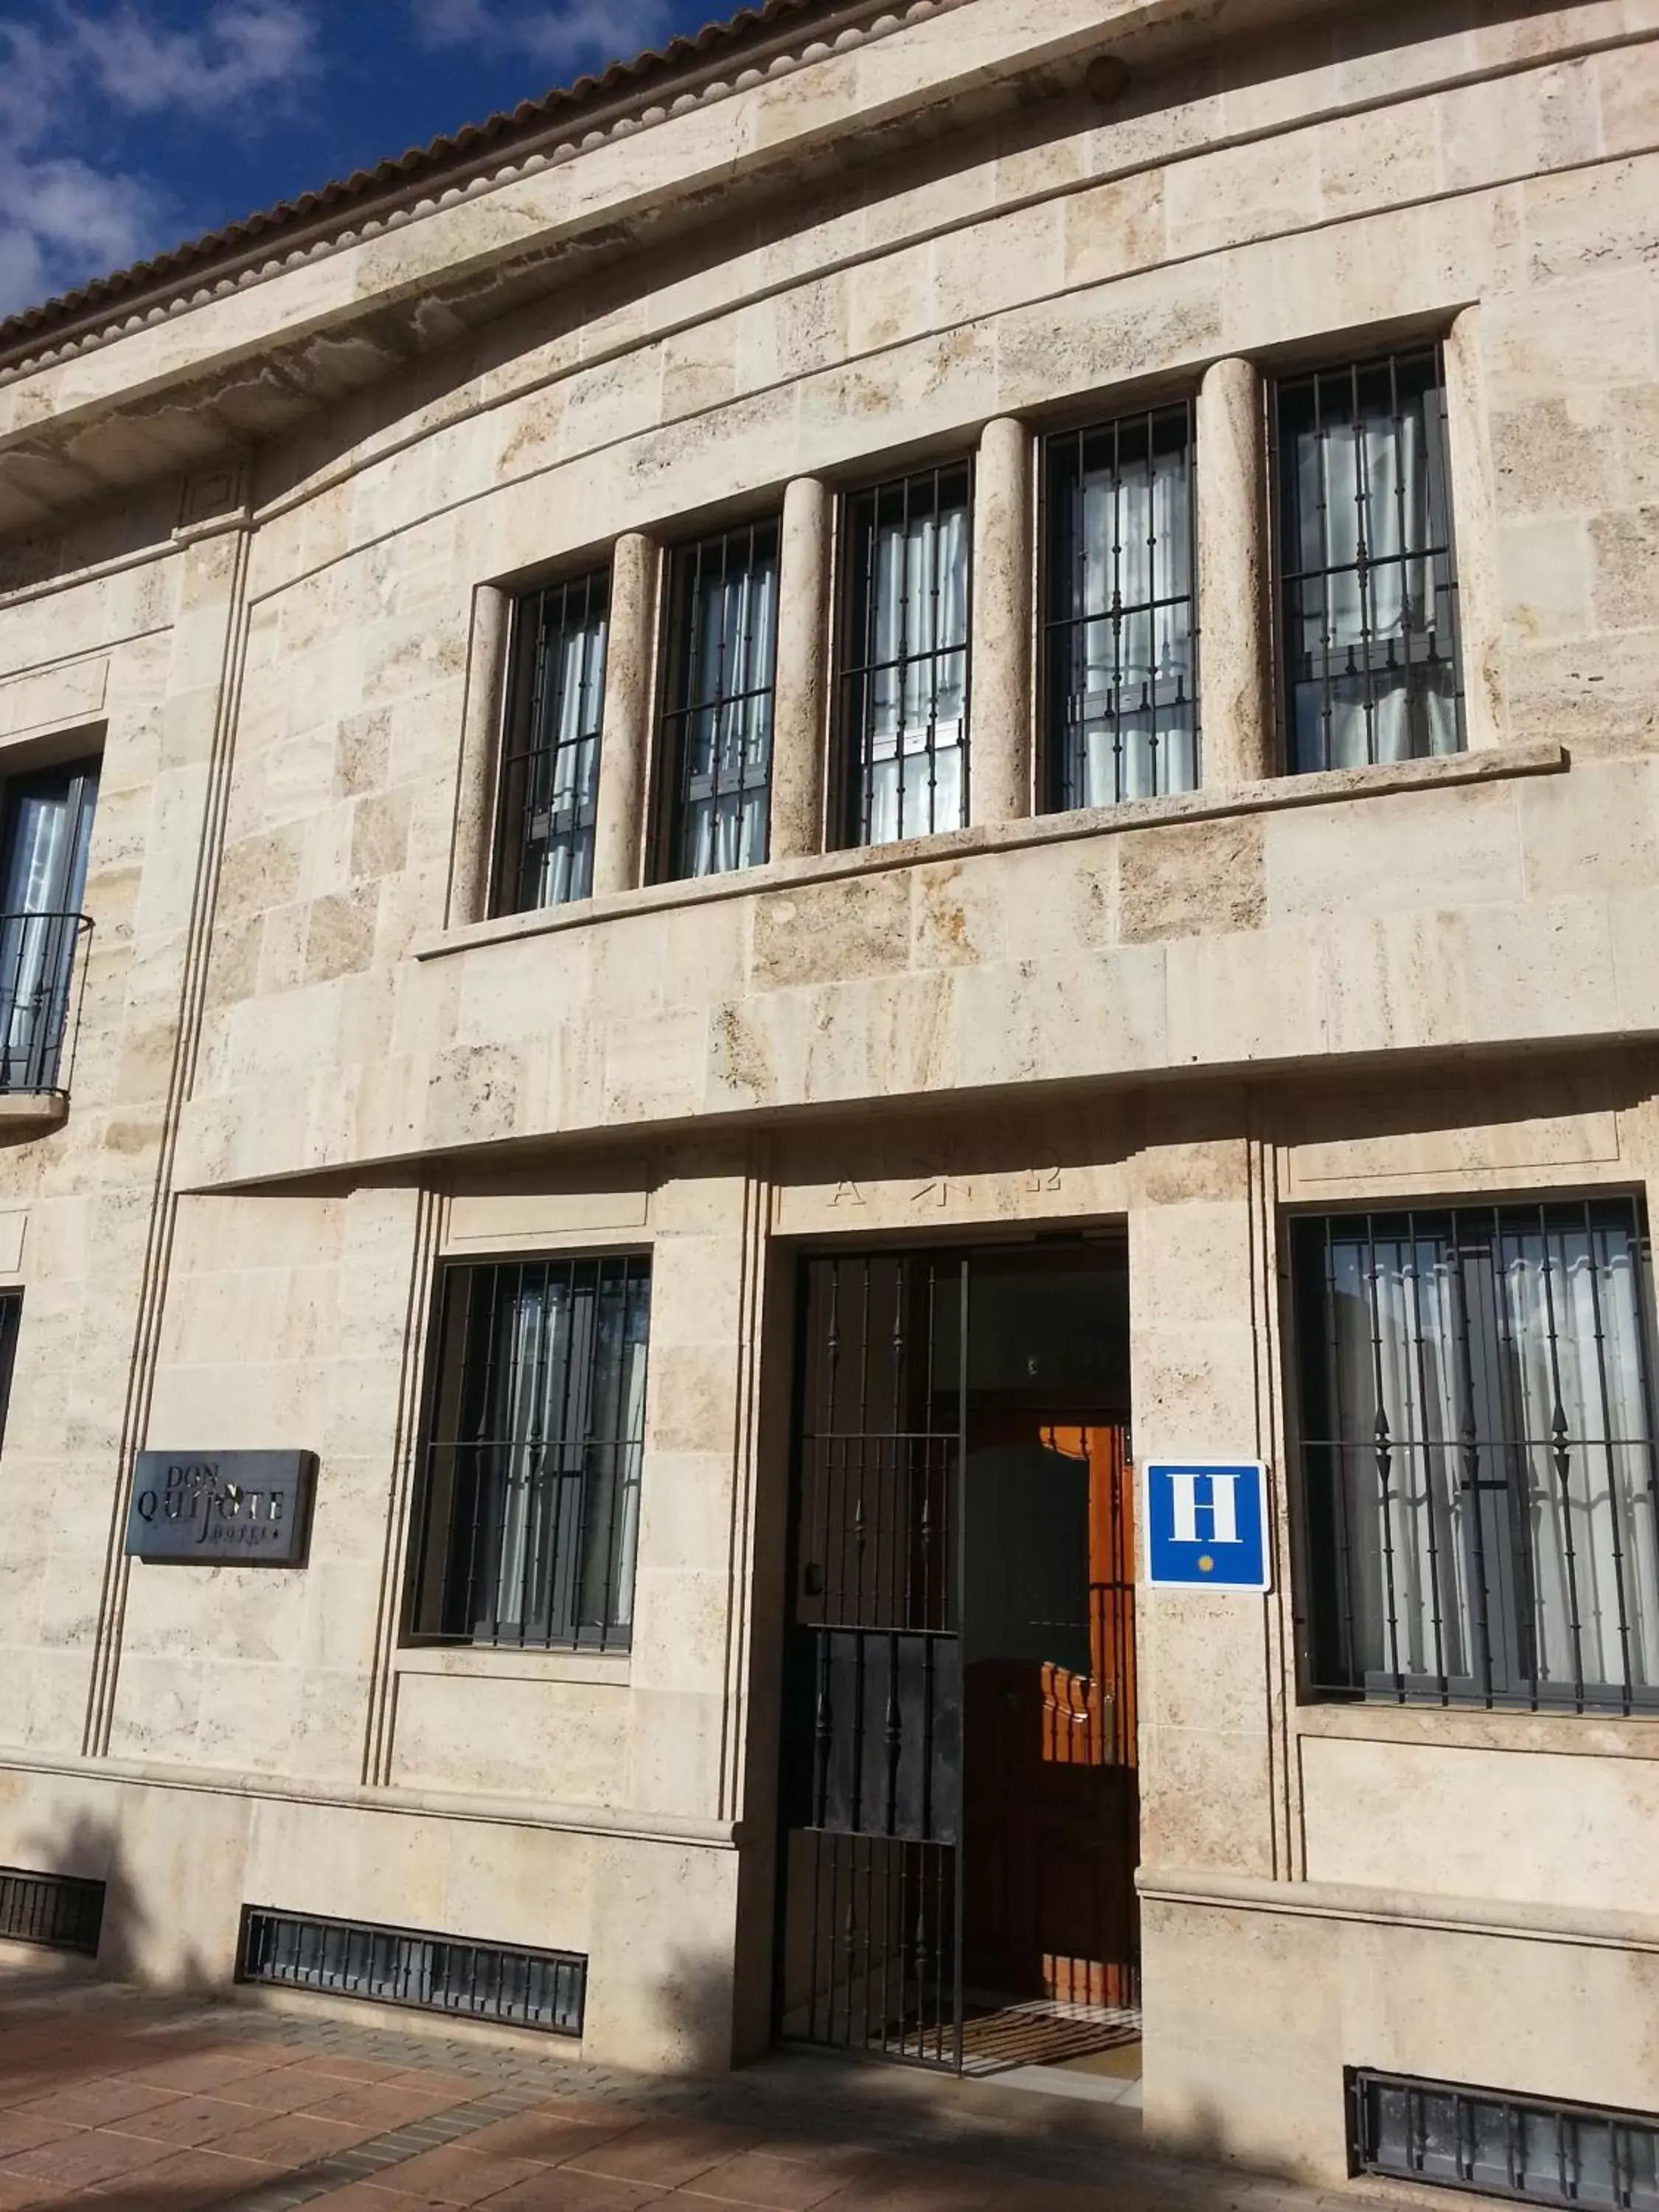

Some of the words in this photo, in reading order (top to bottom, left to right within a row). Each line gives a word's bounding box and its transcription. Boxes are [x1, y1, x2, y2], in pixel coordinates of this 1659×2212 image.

[165, 1465, 220, 1489] DON
[137, 1489, 285, 1543] QUIJOTE
[1166, 1473, 1244, 1543] H
